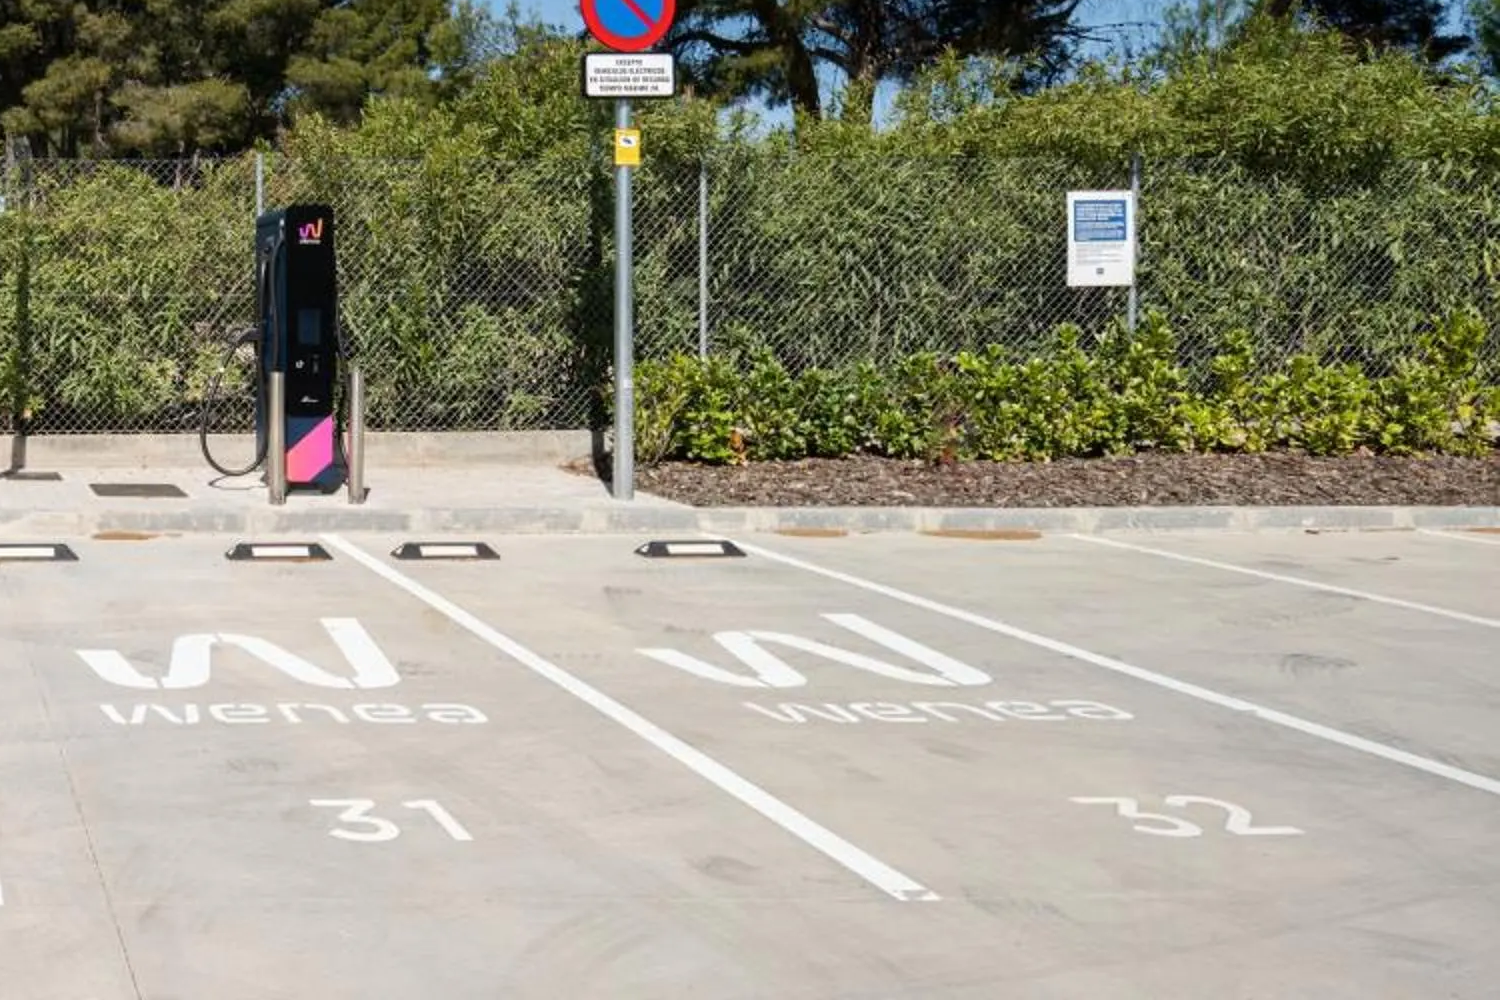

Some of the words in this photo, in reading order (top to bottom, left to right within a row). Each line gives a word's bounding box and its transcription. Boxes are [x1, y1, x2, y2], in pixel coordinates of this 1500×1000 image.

[100, 703, 488, 725] wenea
[309, 799, 473, 842] 31
[1069, 796, 1304, 837] 32
